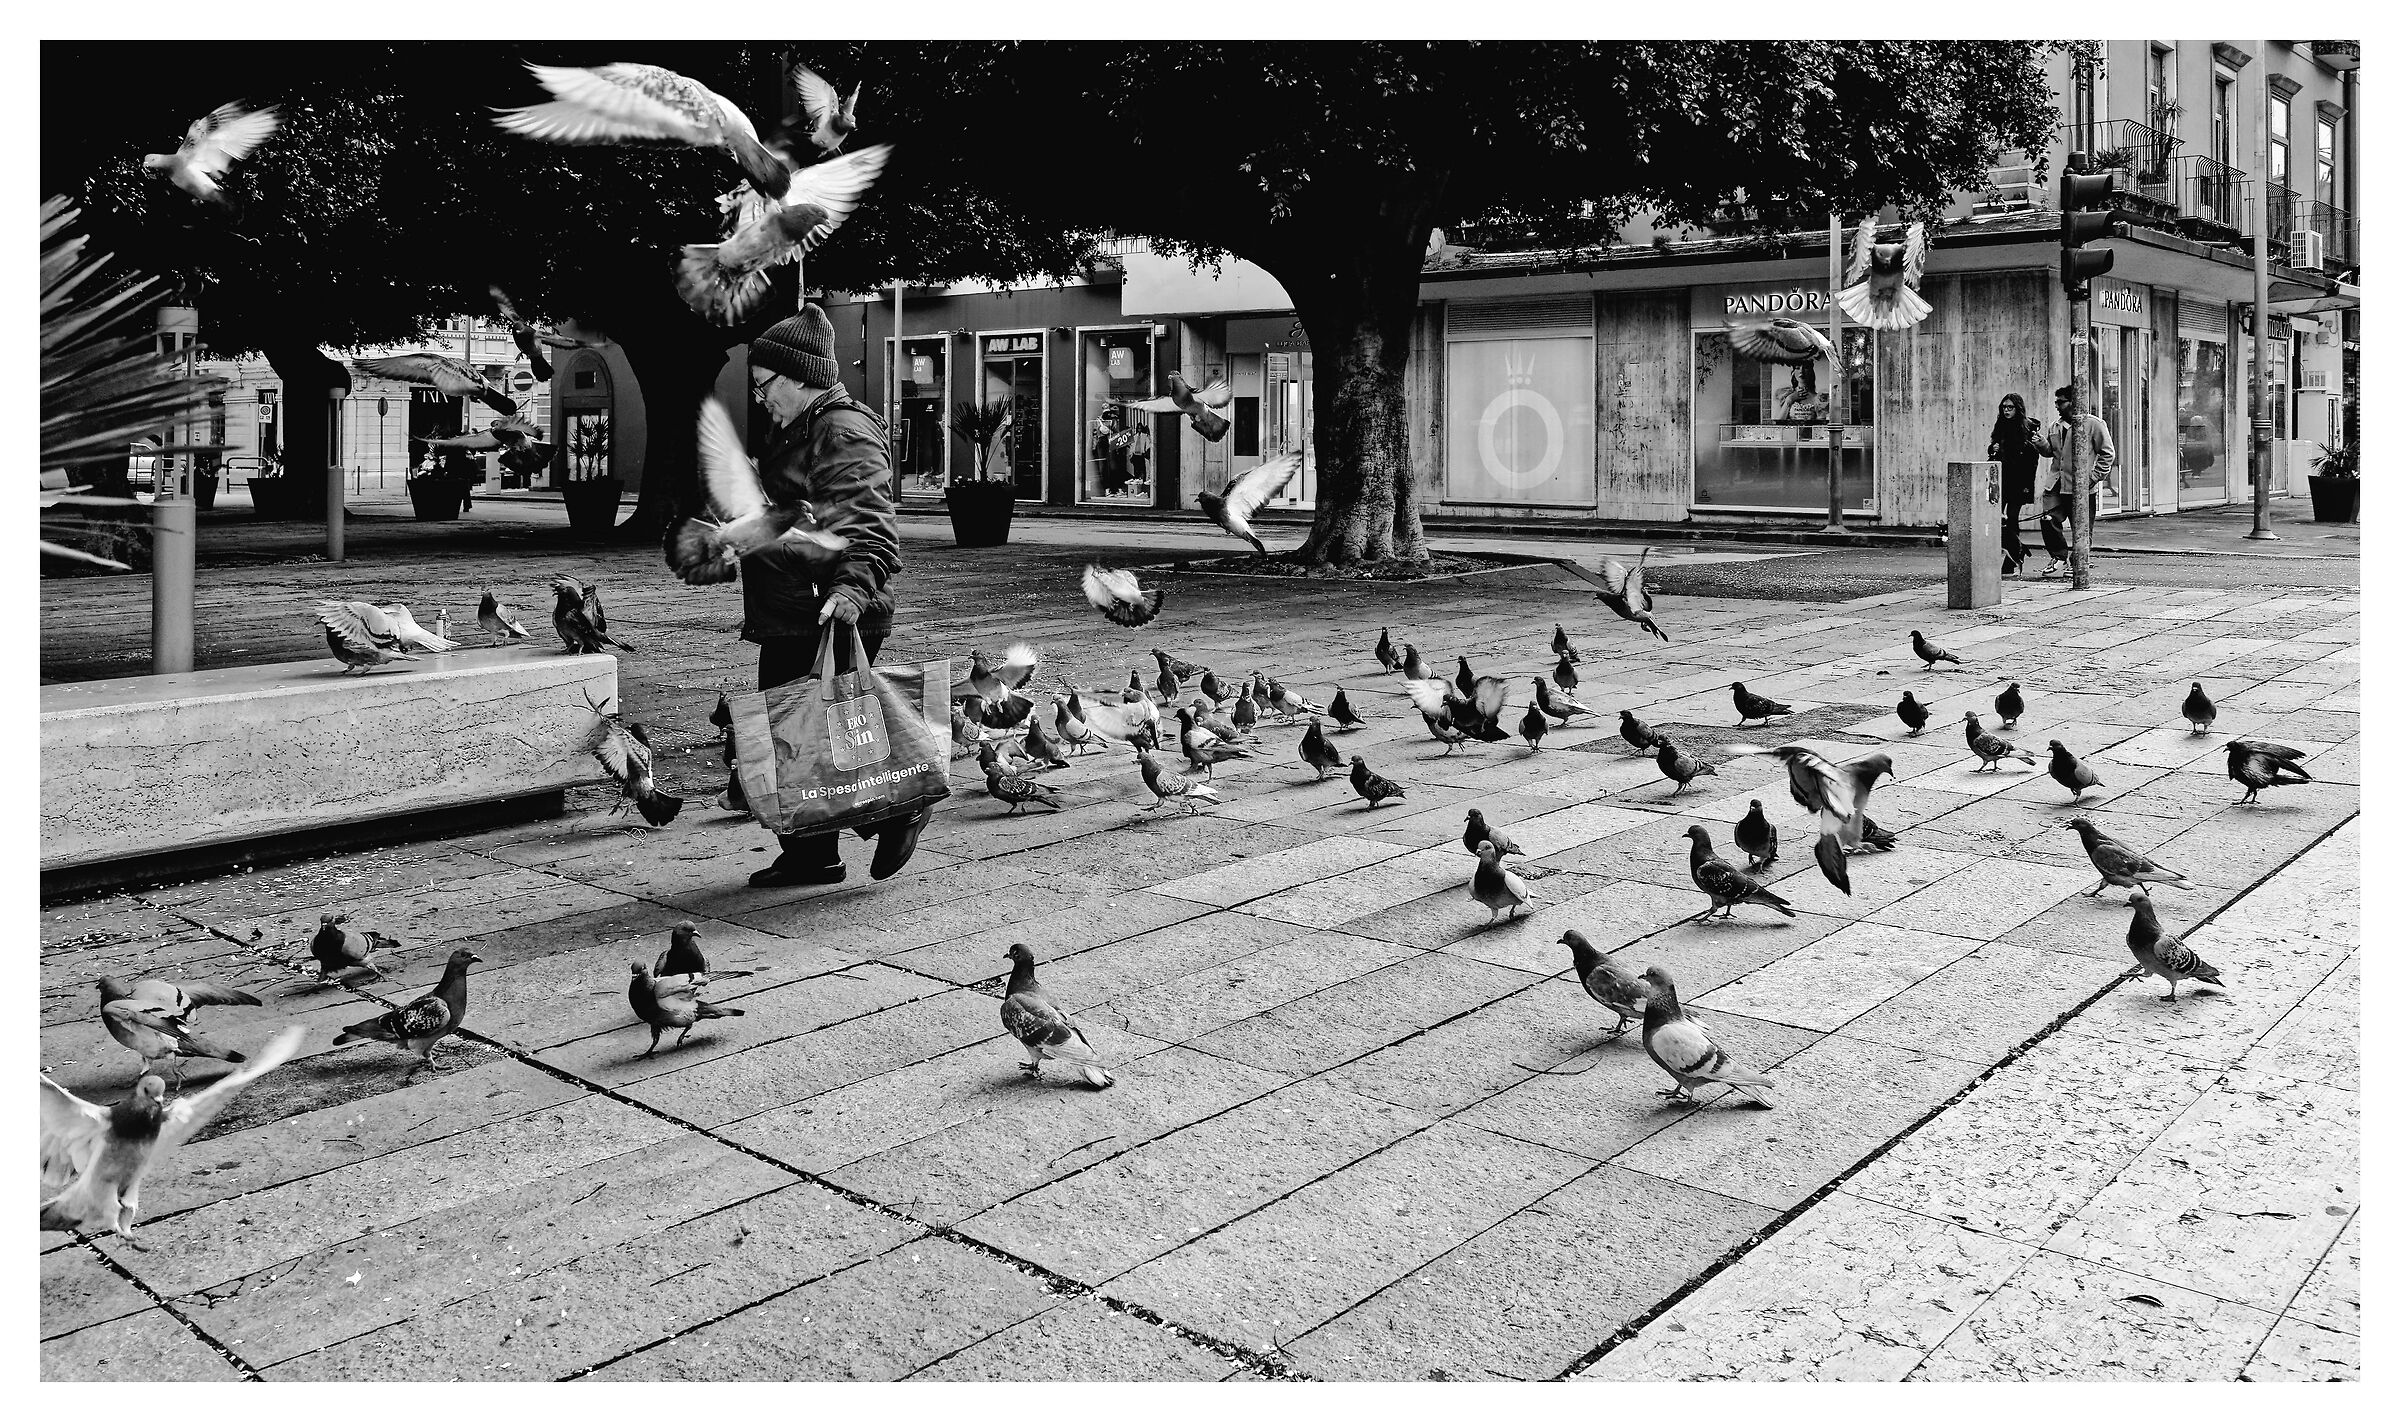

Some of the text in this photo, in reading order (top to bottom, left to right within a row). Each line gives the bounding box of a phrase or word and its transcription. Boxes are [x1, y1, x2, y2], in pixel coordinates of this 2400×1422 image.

[1723, 290, 1831, 314] PANDORA
[2104, 290, 2143, 314] PANDORA
[1111, 350, 1124, 359] AW
[914, 358, 926, 367] AW
[801, 788, 818, 800] La
